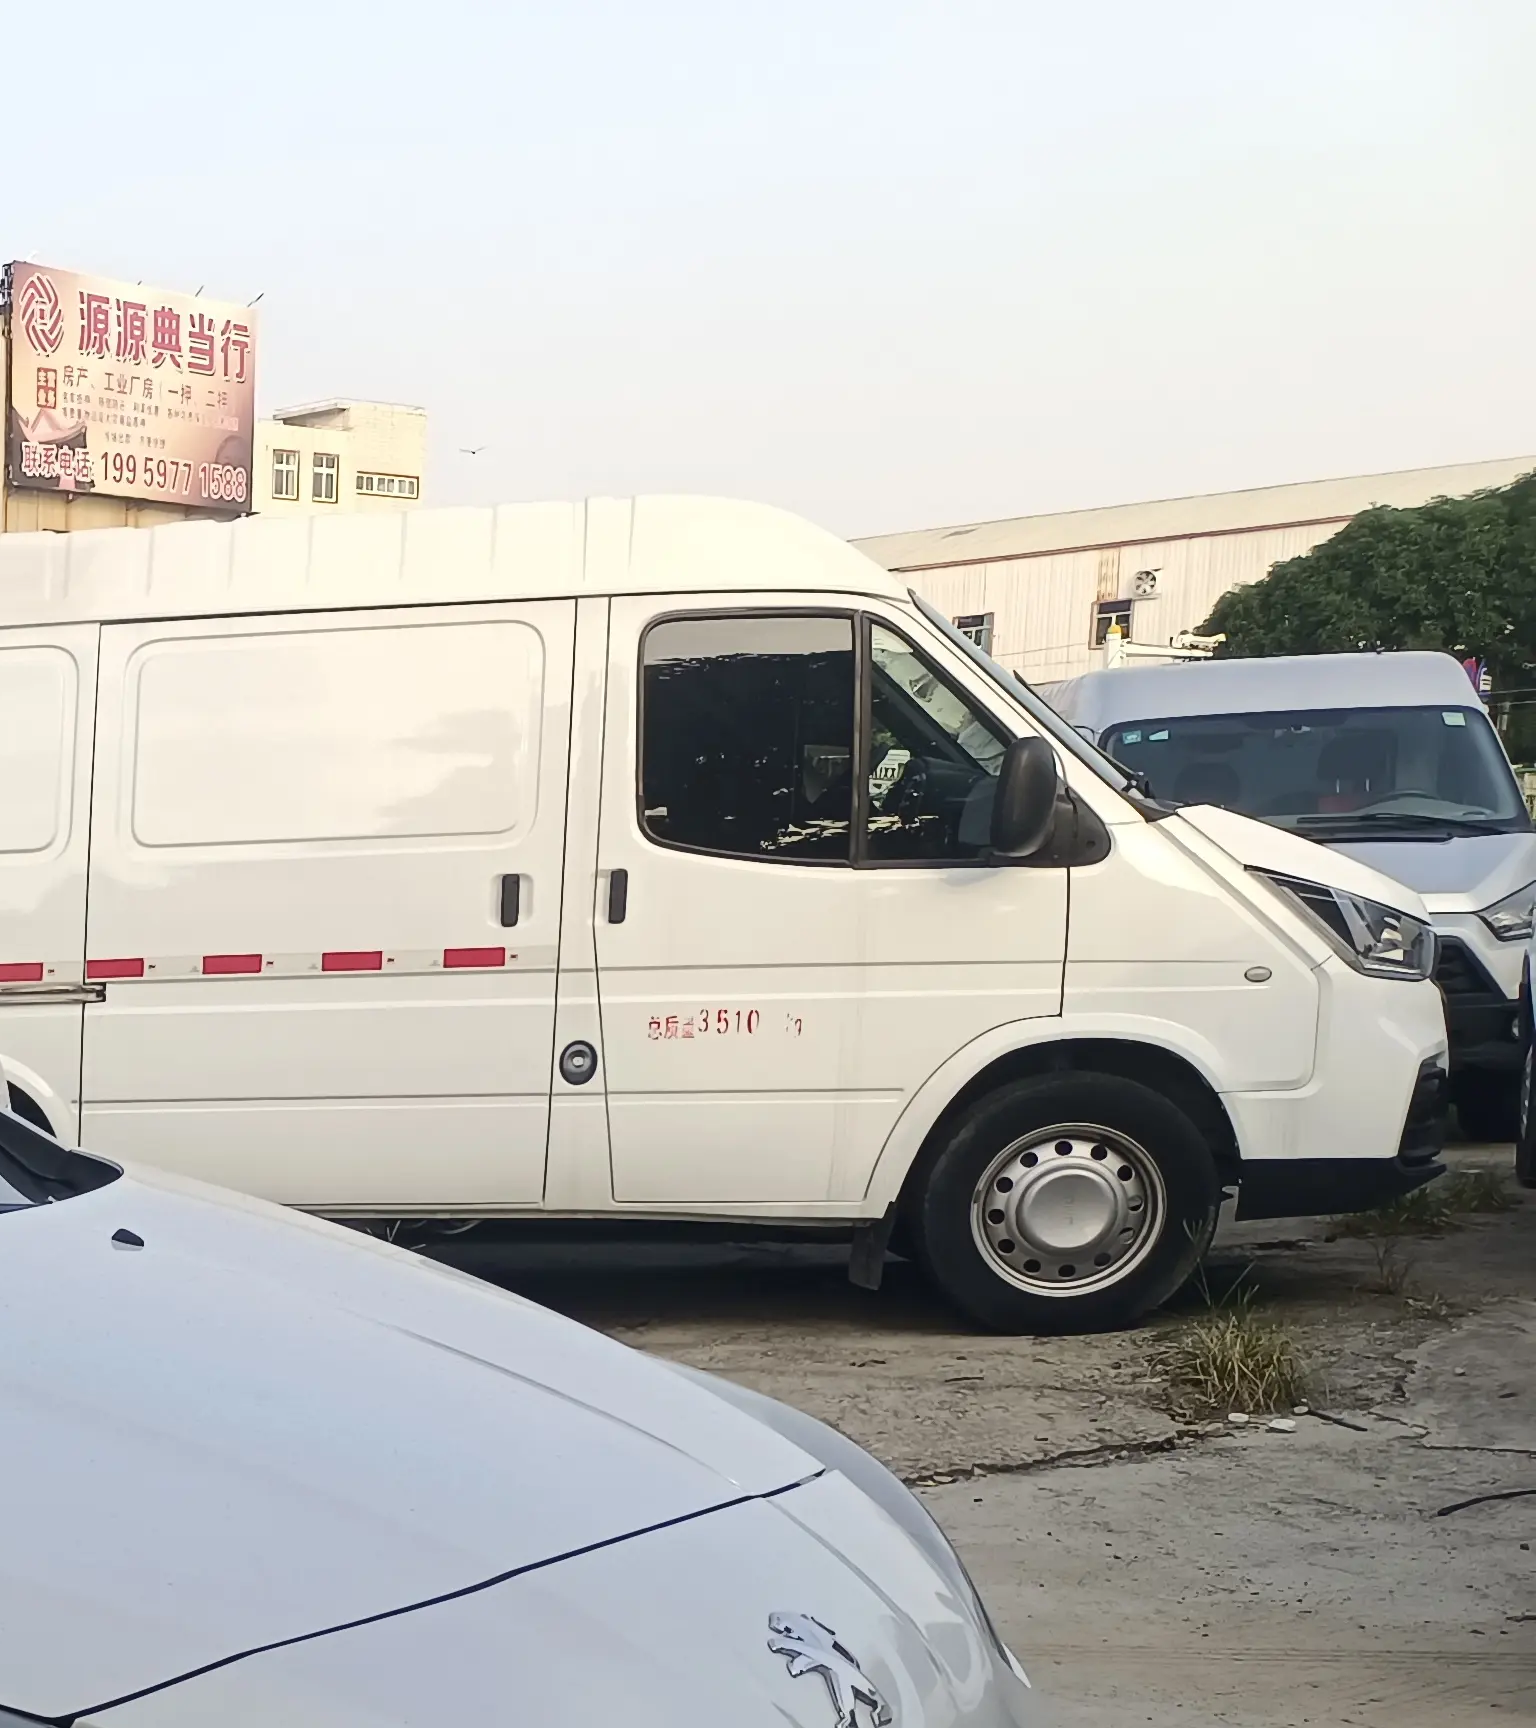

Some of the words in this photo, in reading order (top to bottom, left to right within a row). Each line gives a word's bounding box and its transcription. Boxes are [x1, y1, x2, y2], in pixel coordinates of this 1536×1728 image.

[78, 290, 250, 383] 源源典当行
[101, 451, 137, 485] 199
[143, 456, 193, 493] 5977
[200, 463, 247, 501] 1588
